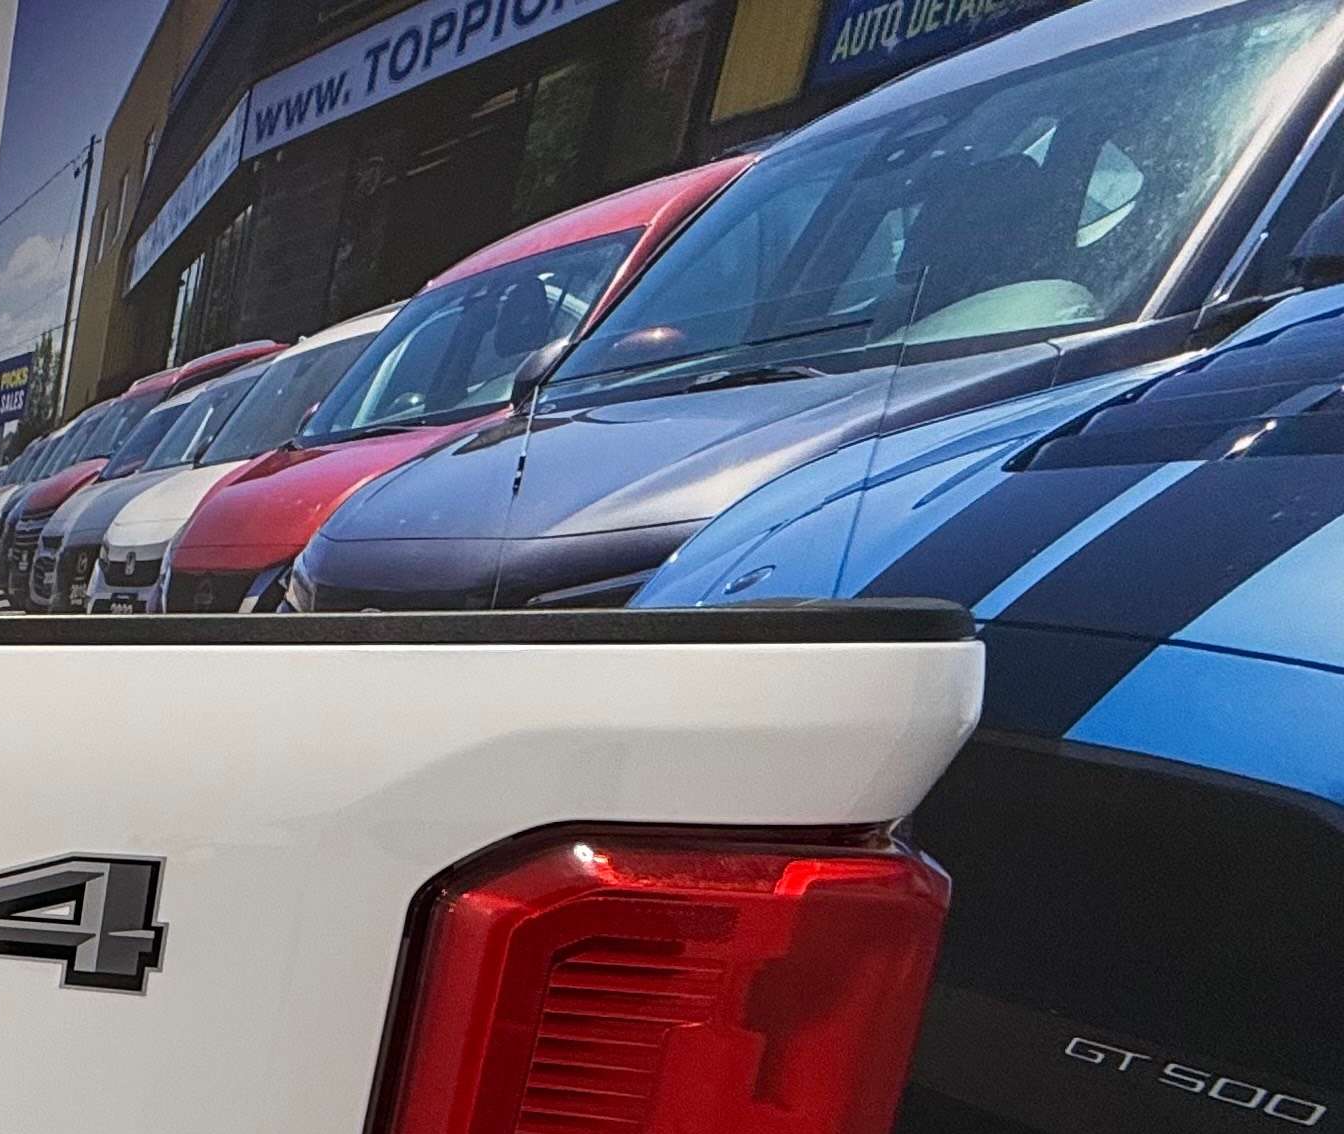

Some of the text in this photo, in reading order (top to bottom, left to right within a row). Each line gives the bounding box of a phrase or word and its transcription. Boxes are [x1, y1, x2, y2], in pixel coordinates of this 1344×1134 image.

[363, 0, 586, 97] TOPPI
[830, 1, 904, 64] AUTO
[0, 389, 25, 414] SALES
[1064, 1036, 1328, 1127] GT 500
